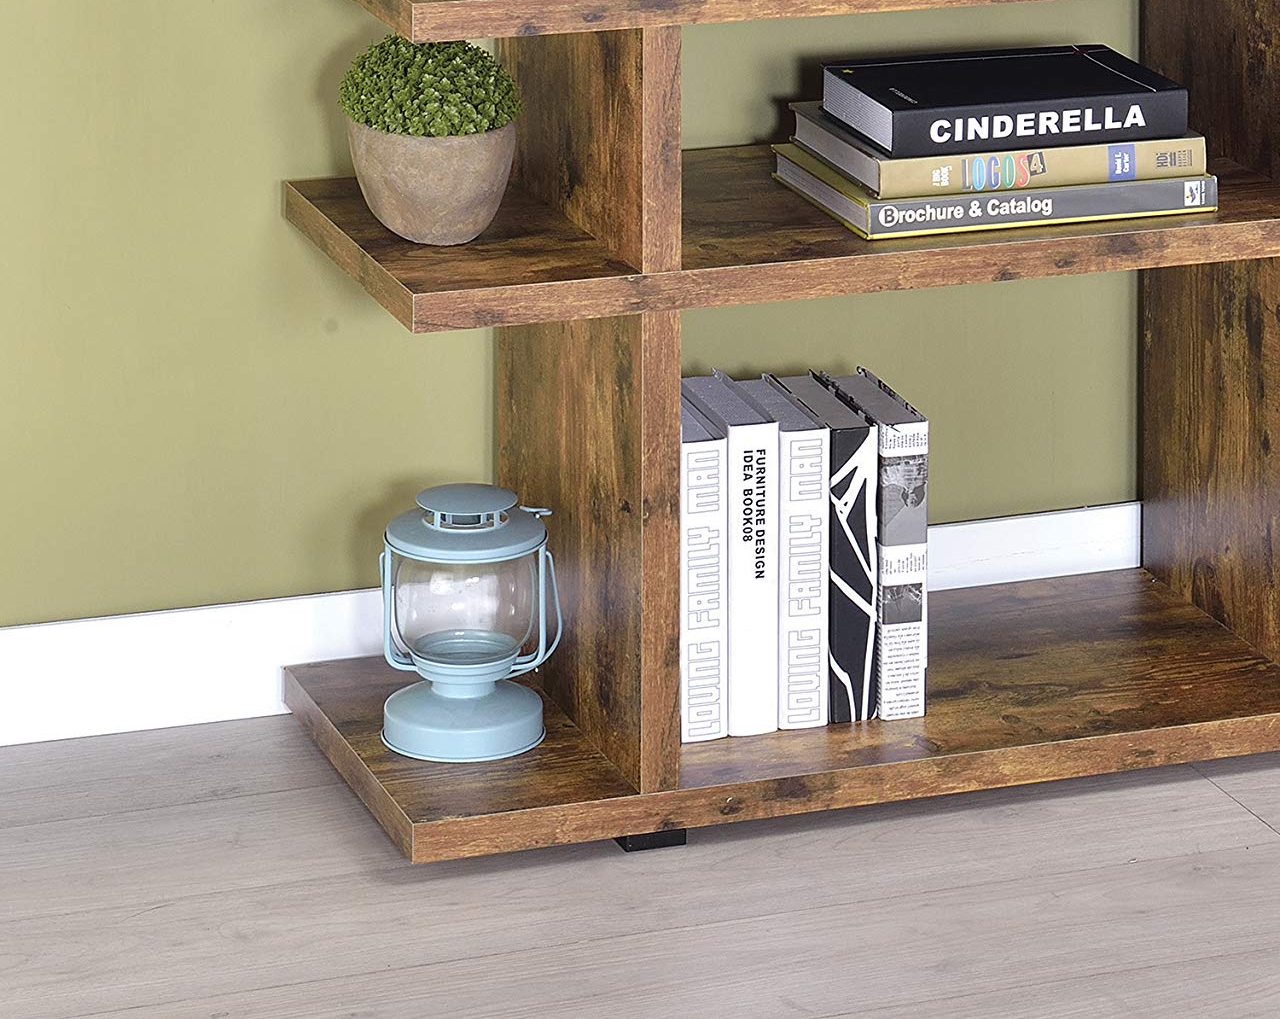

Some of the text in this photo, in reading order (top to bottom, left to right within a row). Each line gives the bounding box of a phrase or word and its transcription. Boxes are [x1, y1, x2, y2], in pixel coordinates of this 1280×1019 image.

[929, 104, 1146, 144] CINDERELLA
[961, 153, 1031, 191] LOGOS
[878, 196, 1053, 227] Brochure & Catalog
[687, 449, 720, 514] MAN
[743, 450, 753, 481] IDEA
[789, 438, 822, 501] MAN
[755, 448, 766, 579] FURNITURE DESIGN
[688, 526, 720, 630] FAMILY
[788, 514, 822, 617] FAMILY
